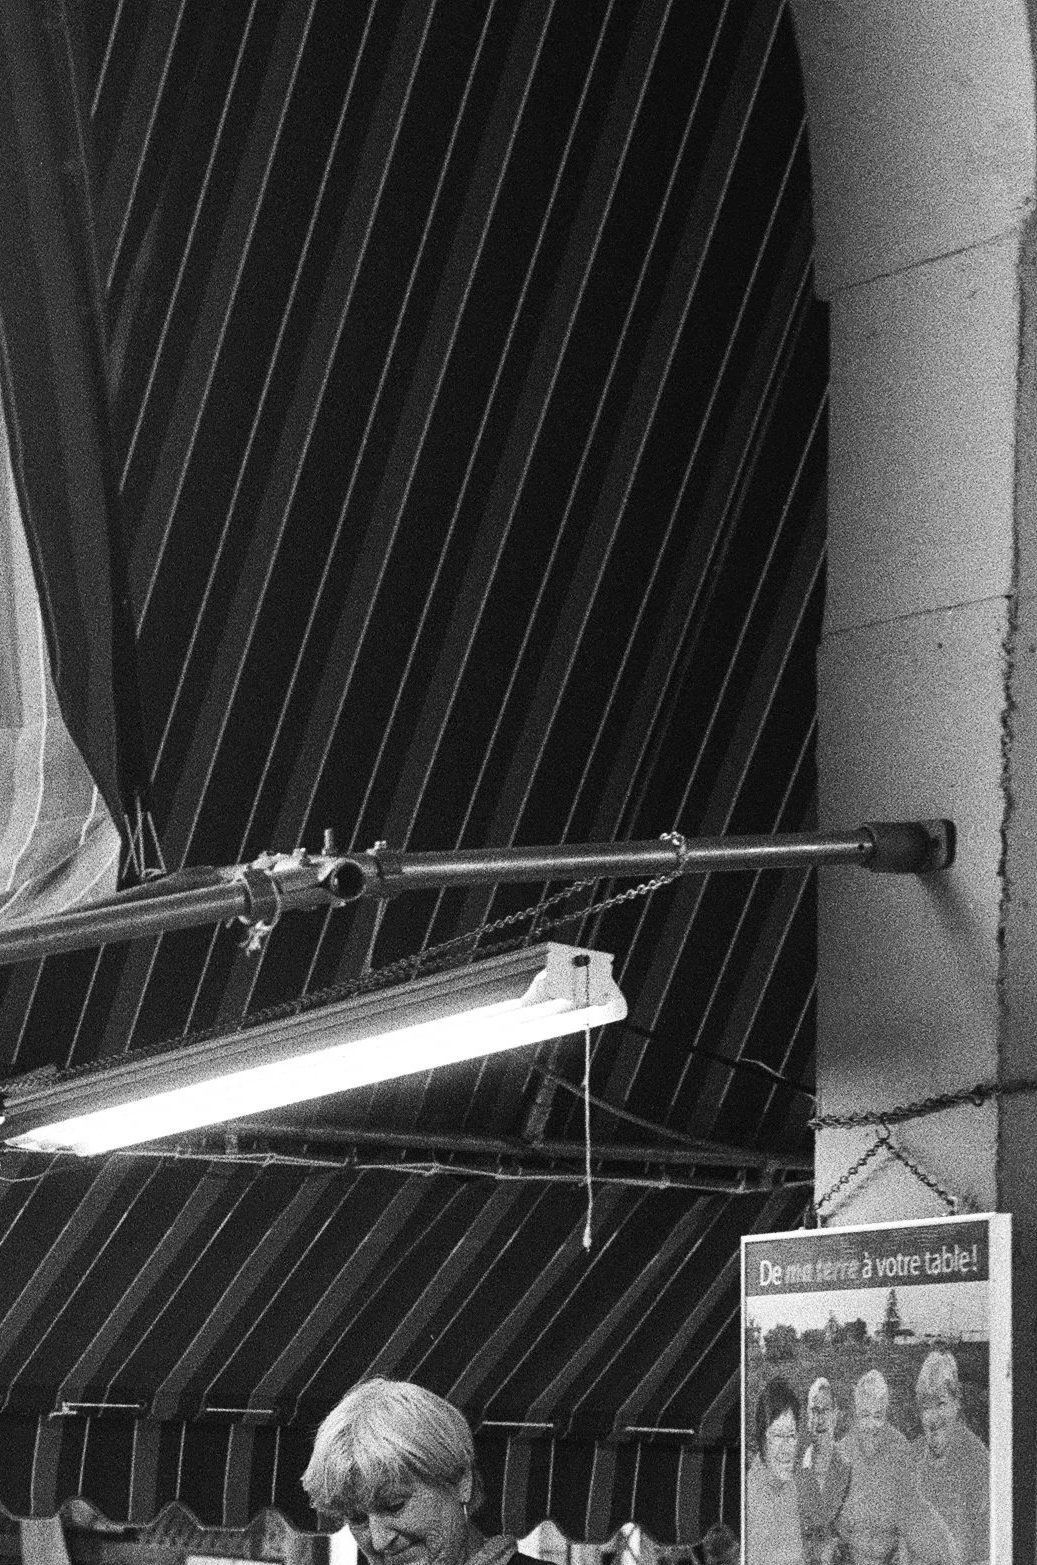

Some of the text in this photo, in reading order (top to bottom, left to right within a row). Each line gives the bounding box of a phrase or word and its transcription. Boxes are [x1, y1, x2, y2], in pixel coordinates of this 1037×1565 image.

[759, 1260, 783, 1286] De
[816, 1259, 858, 1282] terre
[861, 1251, 873, 1279] à
[876, 1253, 921, 1277] votre
[924, 1244, 978, 1276] table!
